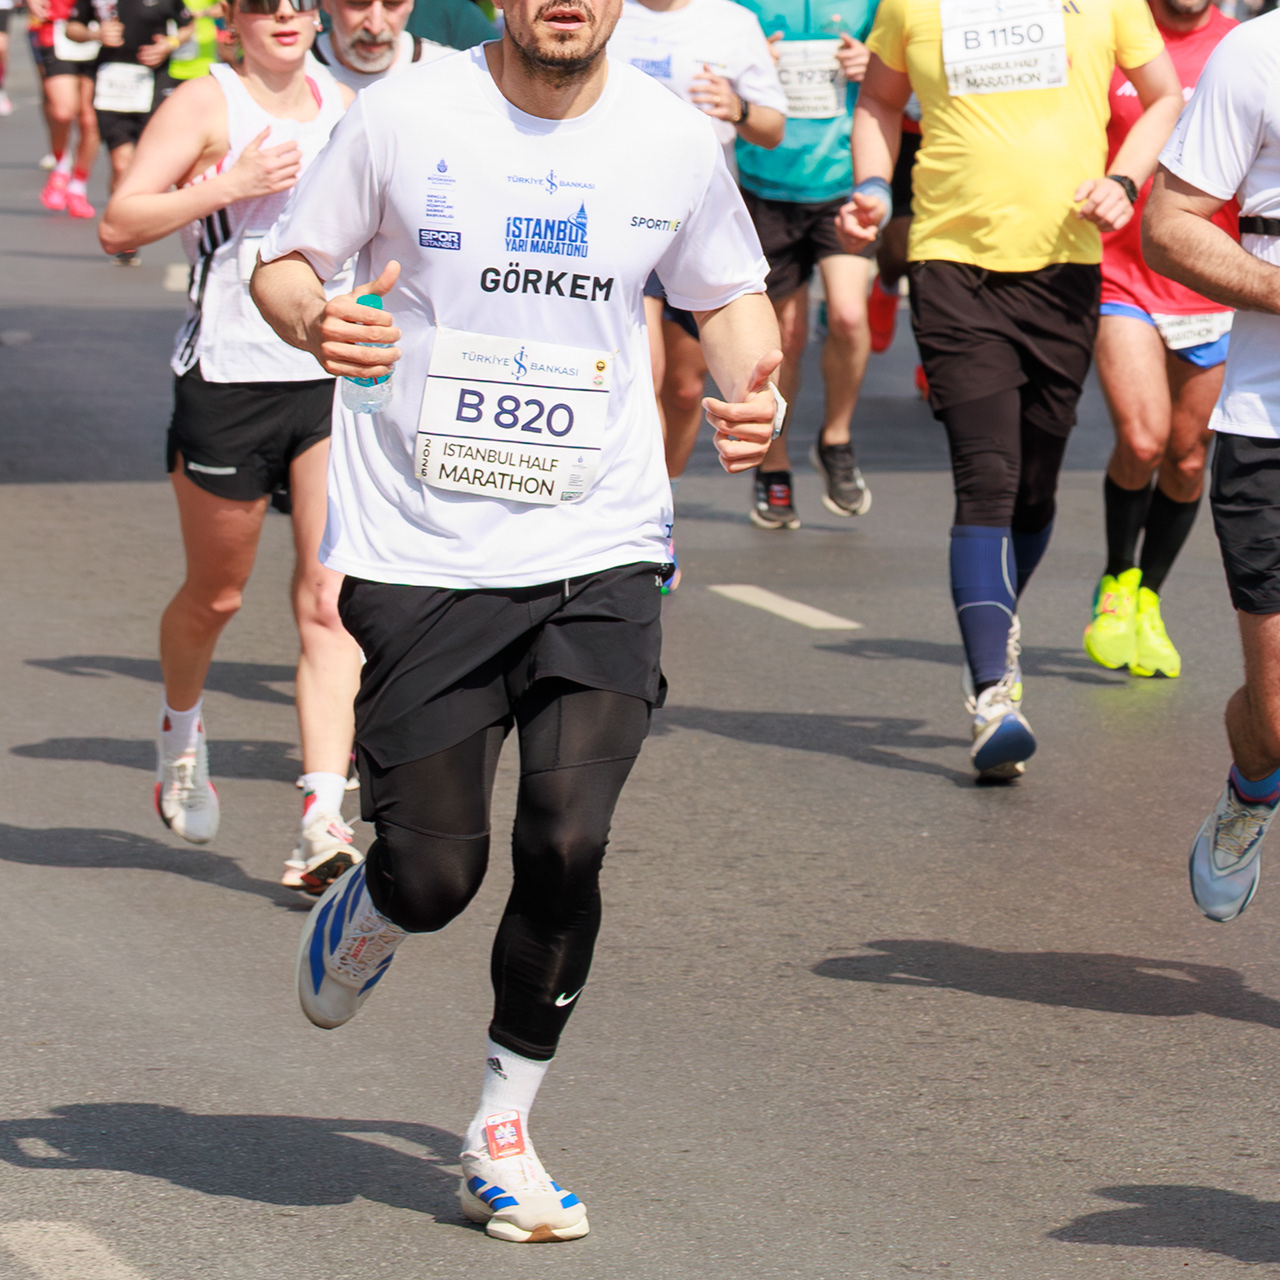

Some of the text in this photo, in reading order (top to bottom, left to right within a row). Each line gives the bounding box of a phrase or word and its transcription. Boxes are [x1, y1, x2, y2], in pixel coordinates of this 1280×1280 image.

[964, 23, 1044, 50] B 1150
[507, 175, 544, 186] TÜRKİYE
[420, 230, 459, 243] SPOR
[506, 216, 588, 244] İSTANBUL
[630, 216, 681, 232] SPORTIVE
[505, 238, 588, 258] YARI MARATONU
[480, 262, 615, 302] GÖRKEM
[462, 351, 510, 367] TÜRKİYE
[530, 362, 579, 377] BANKASI
[456, 388, 574, 437] B 820
[443, 442, 559, 472] ISTANBUL HALF
[438, 463, 555, 496] MARATHON
